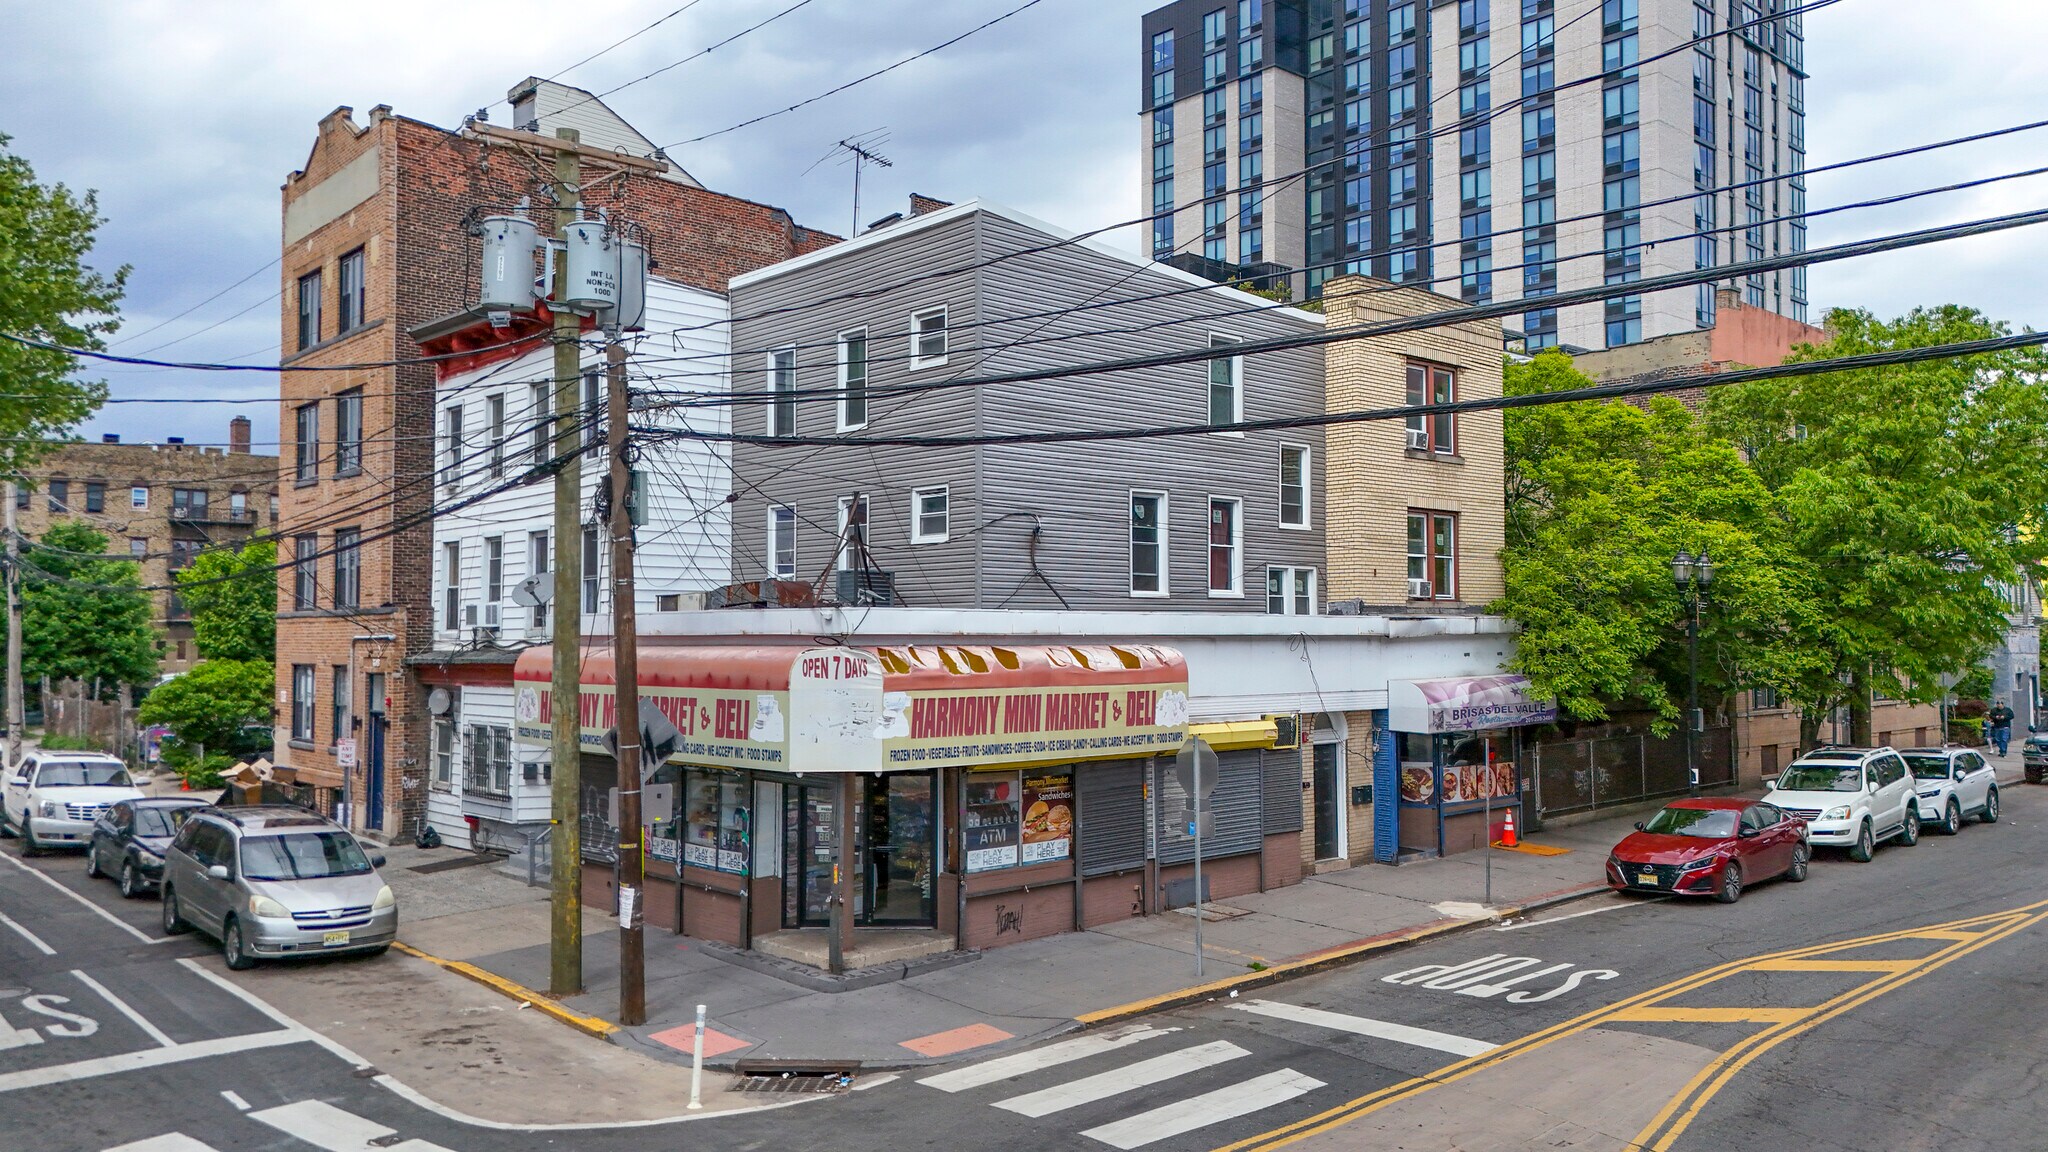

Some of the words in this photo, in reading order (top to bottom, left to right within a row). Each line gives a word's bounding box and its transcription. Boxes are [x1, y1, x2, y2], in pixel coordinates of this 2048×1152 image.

[802, 656, 829, 679] OPEN
[833, 655, 841, 680] 7
[844, 656, 868, 679] DAYS
[911, 696, 1001, 739] HARMONY
[1003, 694, 1042, 734] MINI
[1045, 692, 1109, 731] MARKET
[1112, 699, 1122, 721] &
[1125, 690, 1157, 727] DELI
[1452, 706, 1492, 721] BRISAS
[1494, 704, 1513, 714] DEL
[1515, 702, 1546, 714] VALLE
[700, 706, 711, 730] &
[714, 698, 750, 740] DELI
[890, 749, 911, 762] FROZEN
[1130, 733, 1147, 746] ACCEPT
[1156, 732, 1168, 744] FOOD
[1168, 730, 1184, 743] STAMPS
[715, 746, 733, 759] ACCEPT
[747, 747, 761, 761] FOOD
[761, 750, 782, 763] STAMPS
[1038, 790, 1071, 801] Sandwiches
[980, 828, 1006, 845] ATM
[660, 839, 674, 850] PLAY
[1036, 842, 1056, 850] PLAY
[661, 847, 674, 857] HERE
[694, 846, 709, 857] PLAY
[982, 849, 1003, 858] PLAY
[1036, 849, 1056, 858] HERE
[694, 853, 709, 863] HERE
[726, 852, 741, 863] PLAY
[982, 856, 1003, 866] HERE
[726, 859, 741, 869] HERE
[1380, 953, 1620, 1004] STOP
